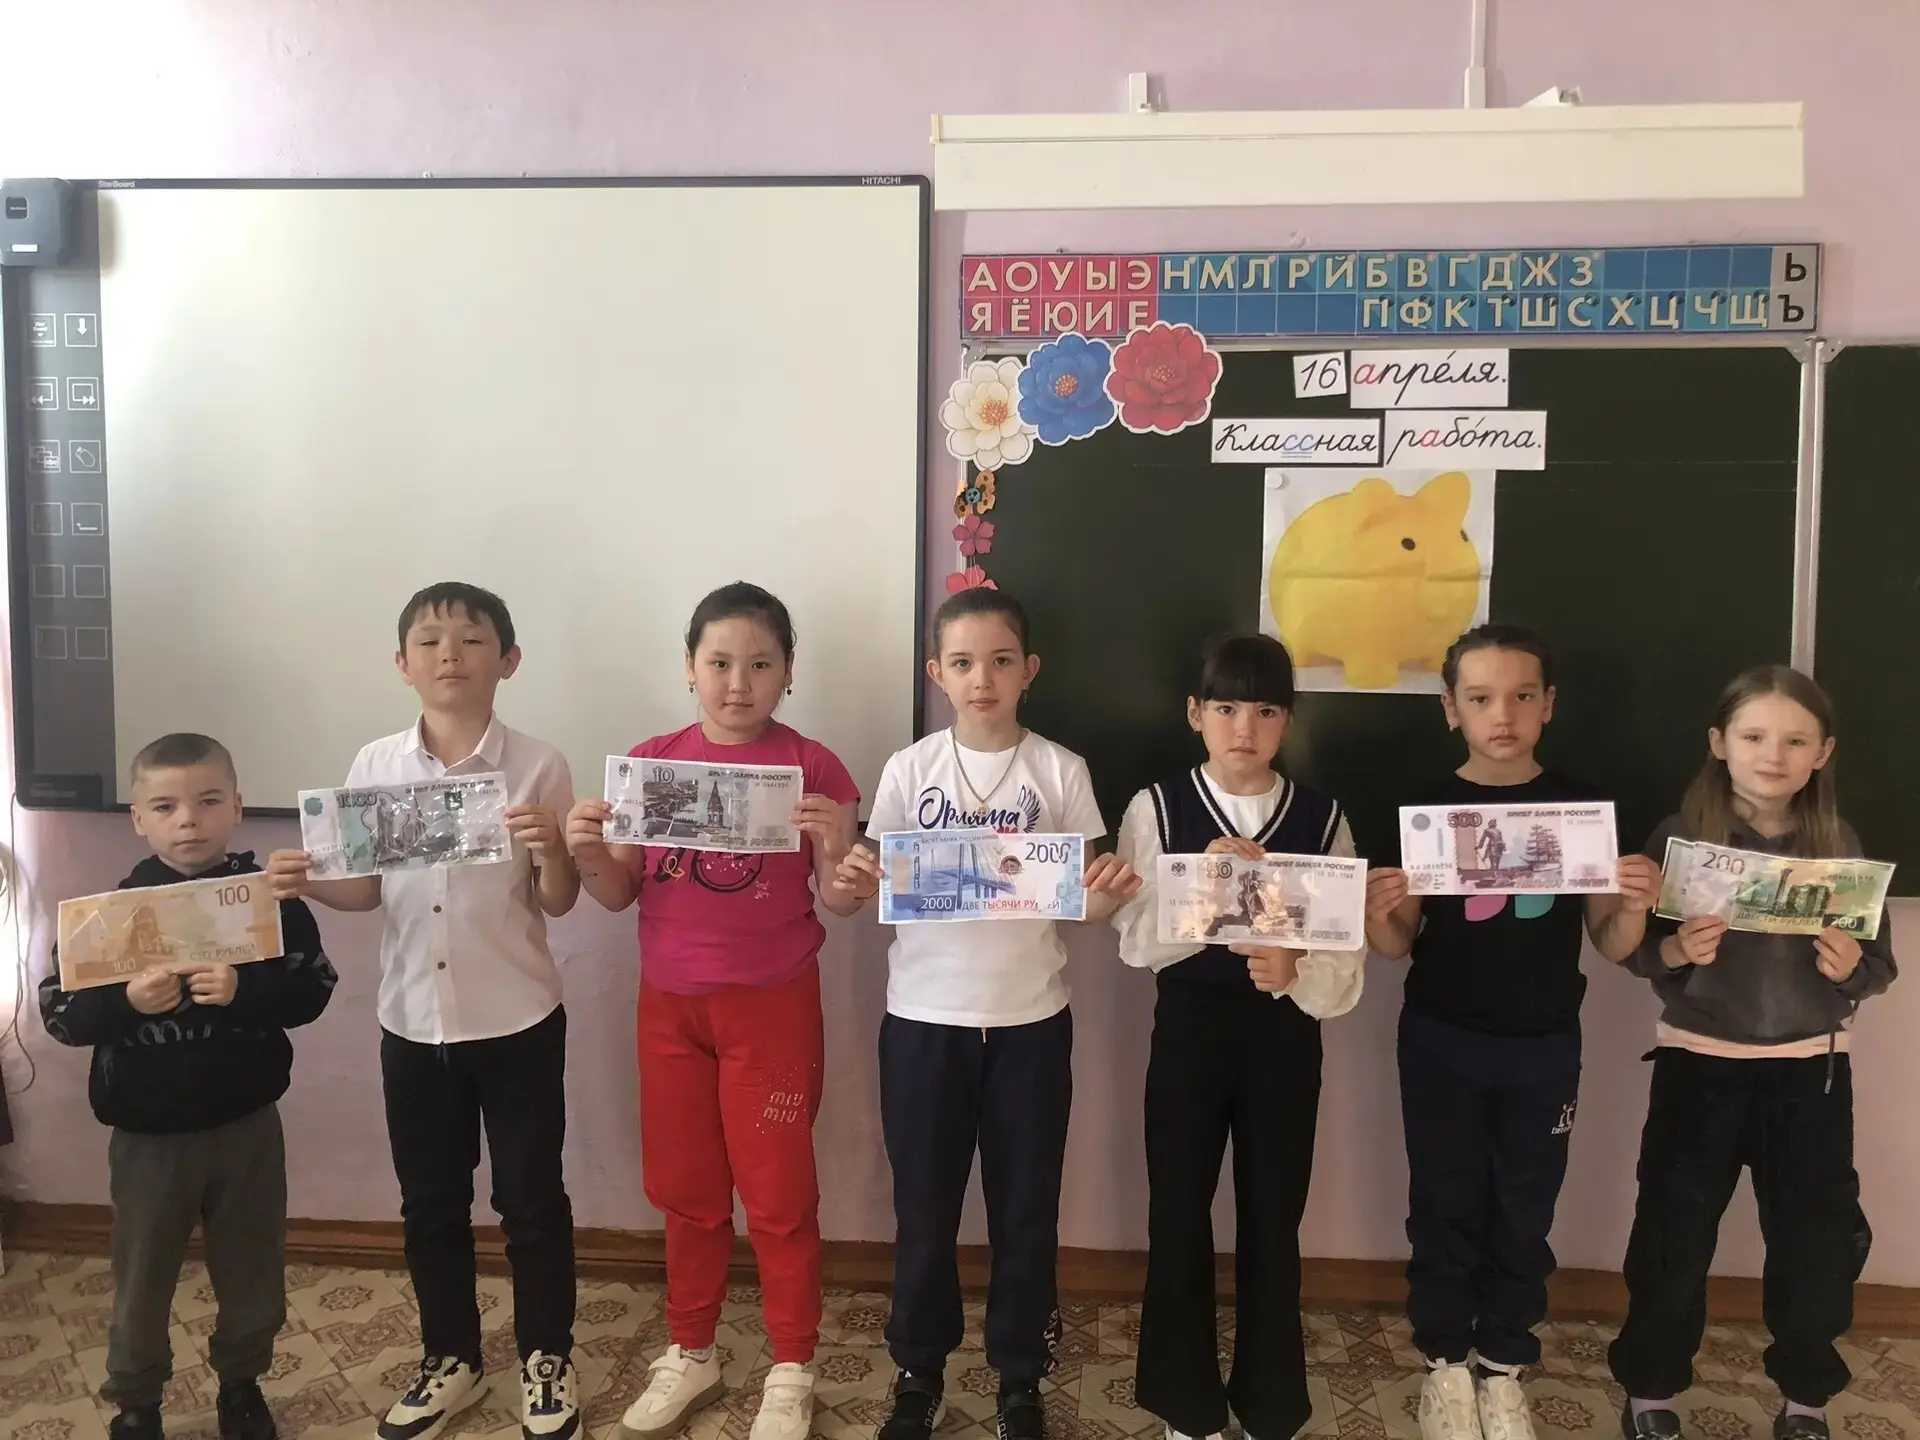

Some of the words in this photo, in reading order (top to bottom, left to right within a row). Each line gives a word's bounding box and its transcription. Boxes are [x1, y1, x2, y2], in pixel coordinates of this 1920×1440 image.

[98, 180, 135, 188] StarBoard
[861, 176, 901, 185] HITACHI
[967, 260, 998, 292] А
[1005, 261, 1038, 293] О
[1048, 261, 1075, 291] У
[1086, 260, 1116, 291] Ы
[1127, 260, 1152, 290] Э
[1163, 259, 1191, 290] Н
[1199, 259, 1235, 289] М
[1242, 258, 1270, 289] Л
[1288, 258, 1310, 289] Р
[1325, 255, 1354, 289] Й
[1366, 257, 1388, 288] Б
[1406, 257, 1428, 288] В
[1448, 256, 1470, 287] Г
[1481, 256, 1513, 291] Д
[1521, 255, 1558, 287] Ж
[1568, 256, 1593, 287] З
[1784, 253, 1807, 282] Ь
[970, 302, 992, 332] Я
[1010, 298, 1031, 332] Ё
[1043, 301, 1078, 332] Ю
[1085, 301, 1113, 332] И
[1128, 301, 1149, 330] Е
[1363, 298, 1389, 328] П
[1400, 298, 1432, 328] Ф
[1444, 298, 1470, 328] К
[1486, 298, 1511, 328] Т
[1521, 297, 1557, 327] Ш
[1567, 297, 1592, 327] С
[1607, 296, 1635, 326] Х
[1650, 296, 1679, 329] Ц
[1694, 295, 1719, 325] Ч
[1730, 294, 1767, 328] Щ
[1777, 294, 1804, 323] Ъ
[1300, 357, 1341, 391] 16
[1214, 423, 1377, 451] Классная
[652, 765, 675, 784] 10
[918, 786, 1021, 829] Орлята
[1447, 811, 1483, 829] 500
[1025, 842, 1072, 864] 2000
[1206, 861, 1233, 879] 50
[1701, 851, 1745, 876] 200
[214, 884, 250, 907] 100
[921, 897, 953, 910] 2000
[961, 900, 980, 912] ДВЕ
[983, 899, 1021, 910] ТЫСЯЧИ
[1830, 916, 1857, 929] 200
[112, 957, 136, 973] 100
